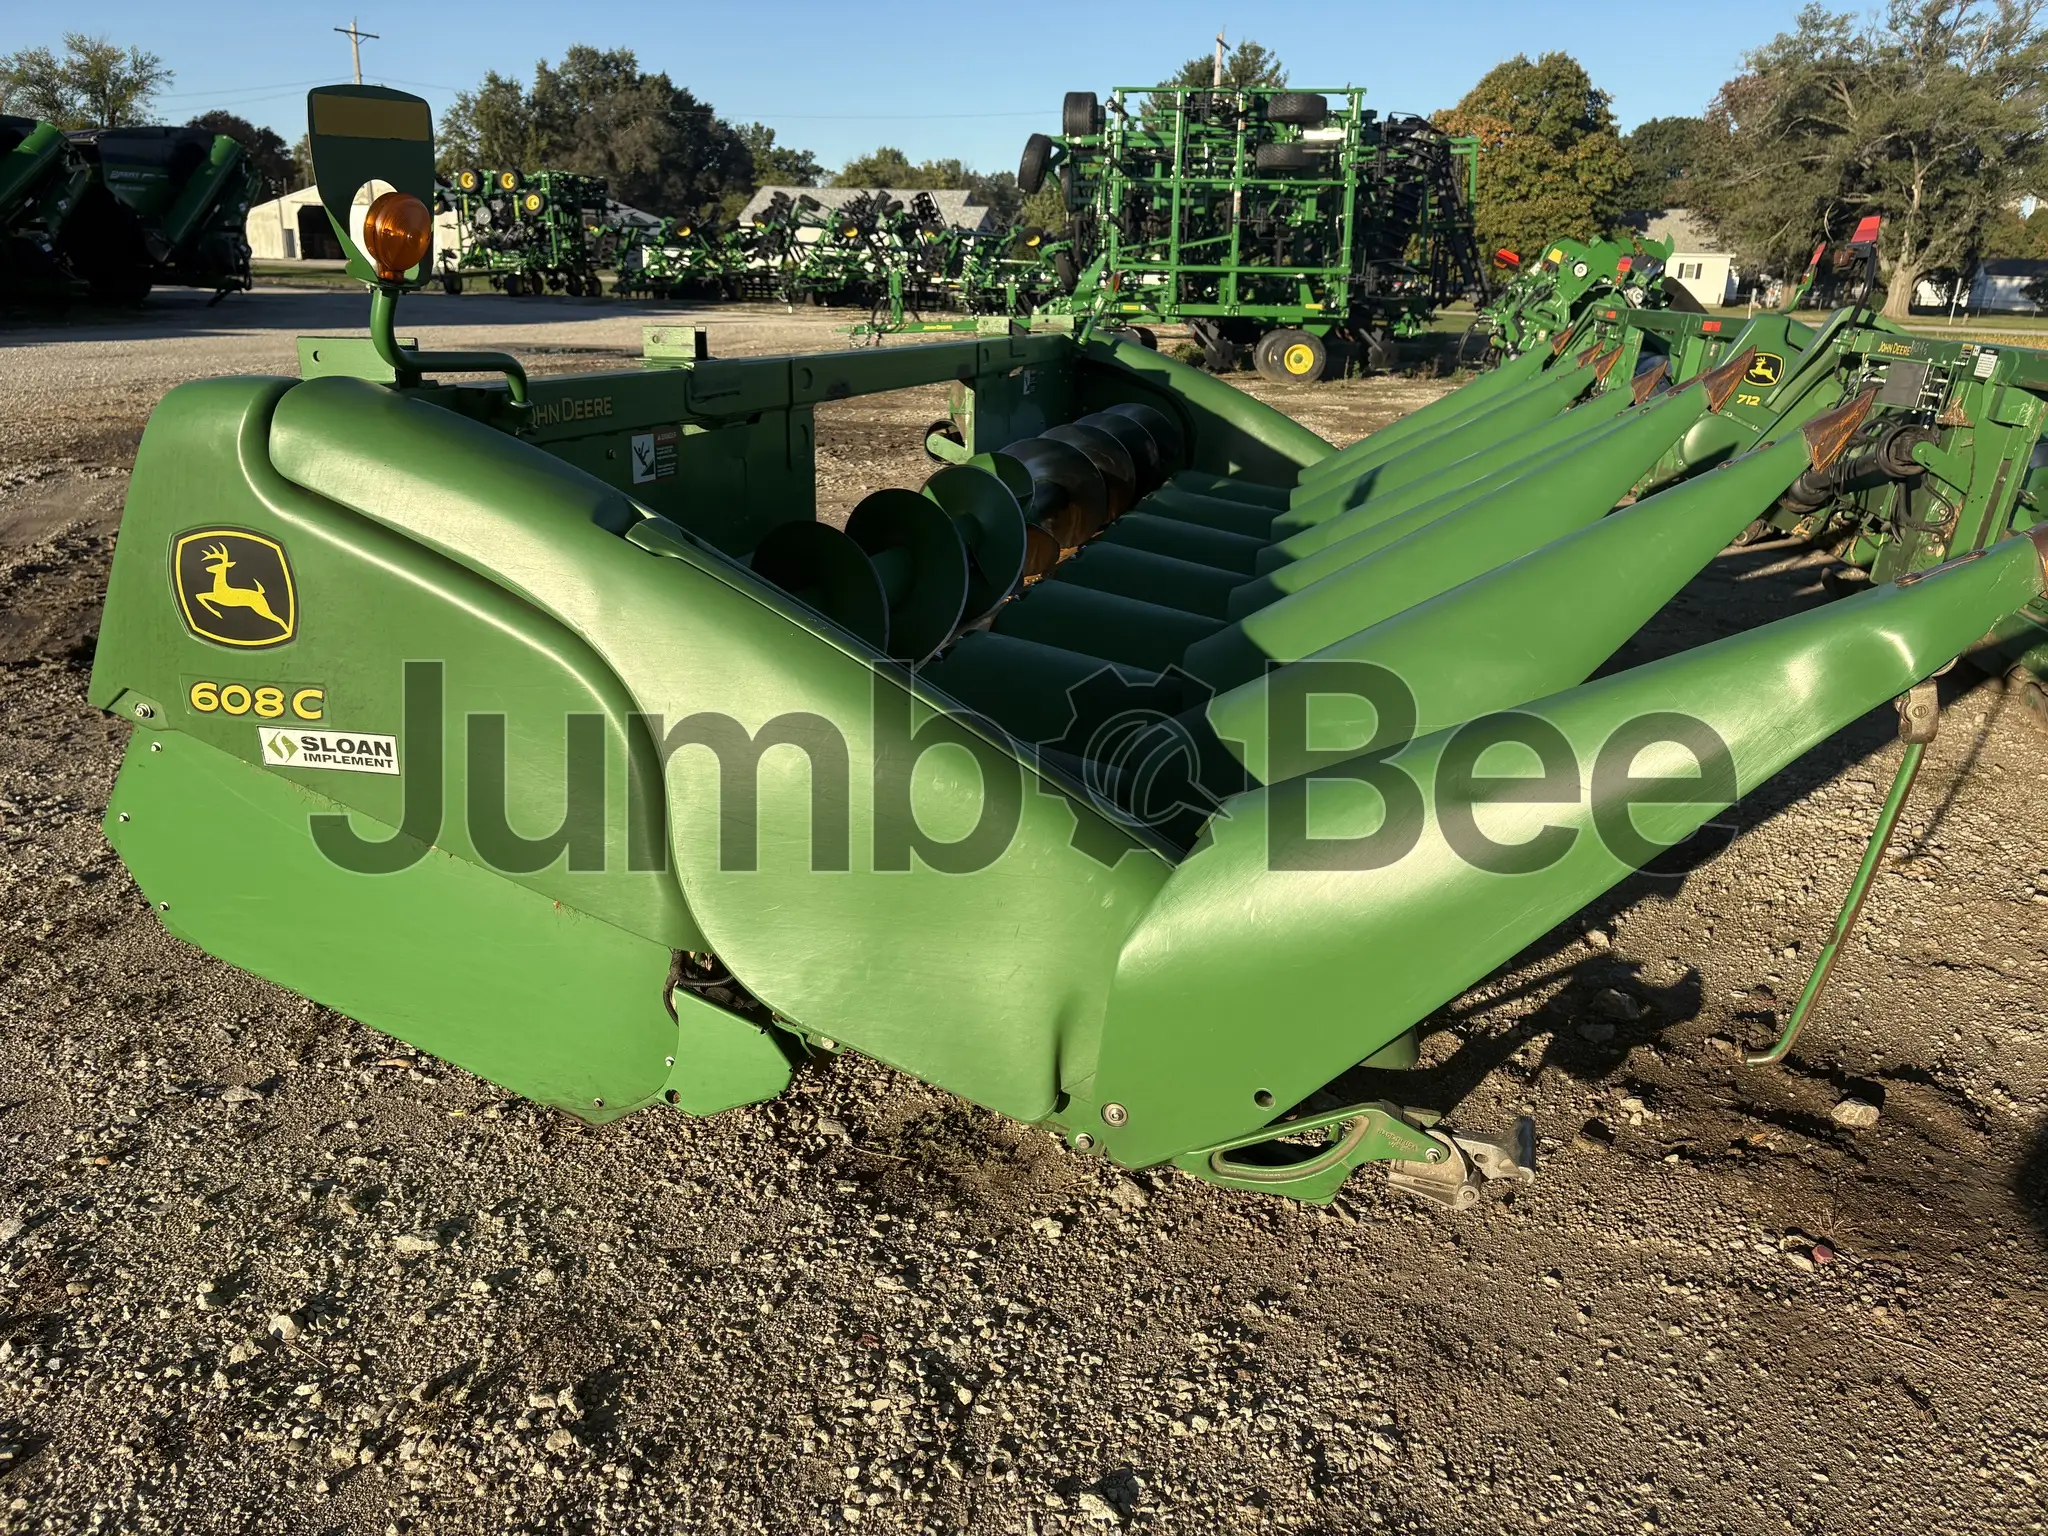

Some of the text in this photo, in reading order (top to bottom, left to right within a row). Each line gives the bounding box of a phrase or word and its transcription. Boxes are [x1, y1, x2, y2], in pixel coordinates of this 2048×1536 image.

[1877, 340, 1912, 356] JOHN DEERE
[1736, 394, 1761, 406] 712
[561, 396, 613, 422] DEERE
[300, 735, 393, 758] SLOAN
[303, 752, 394, 769] IMPLEMENT
